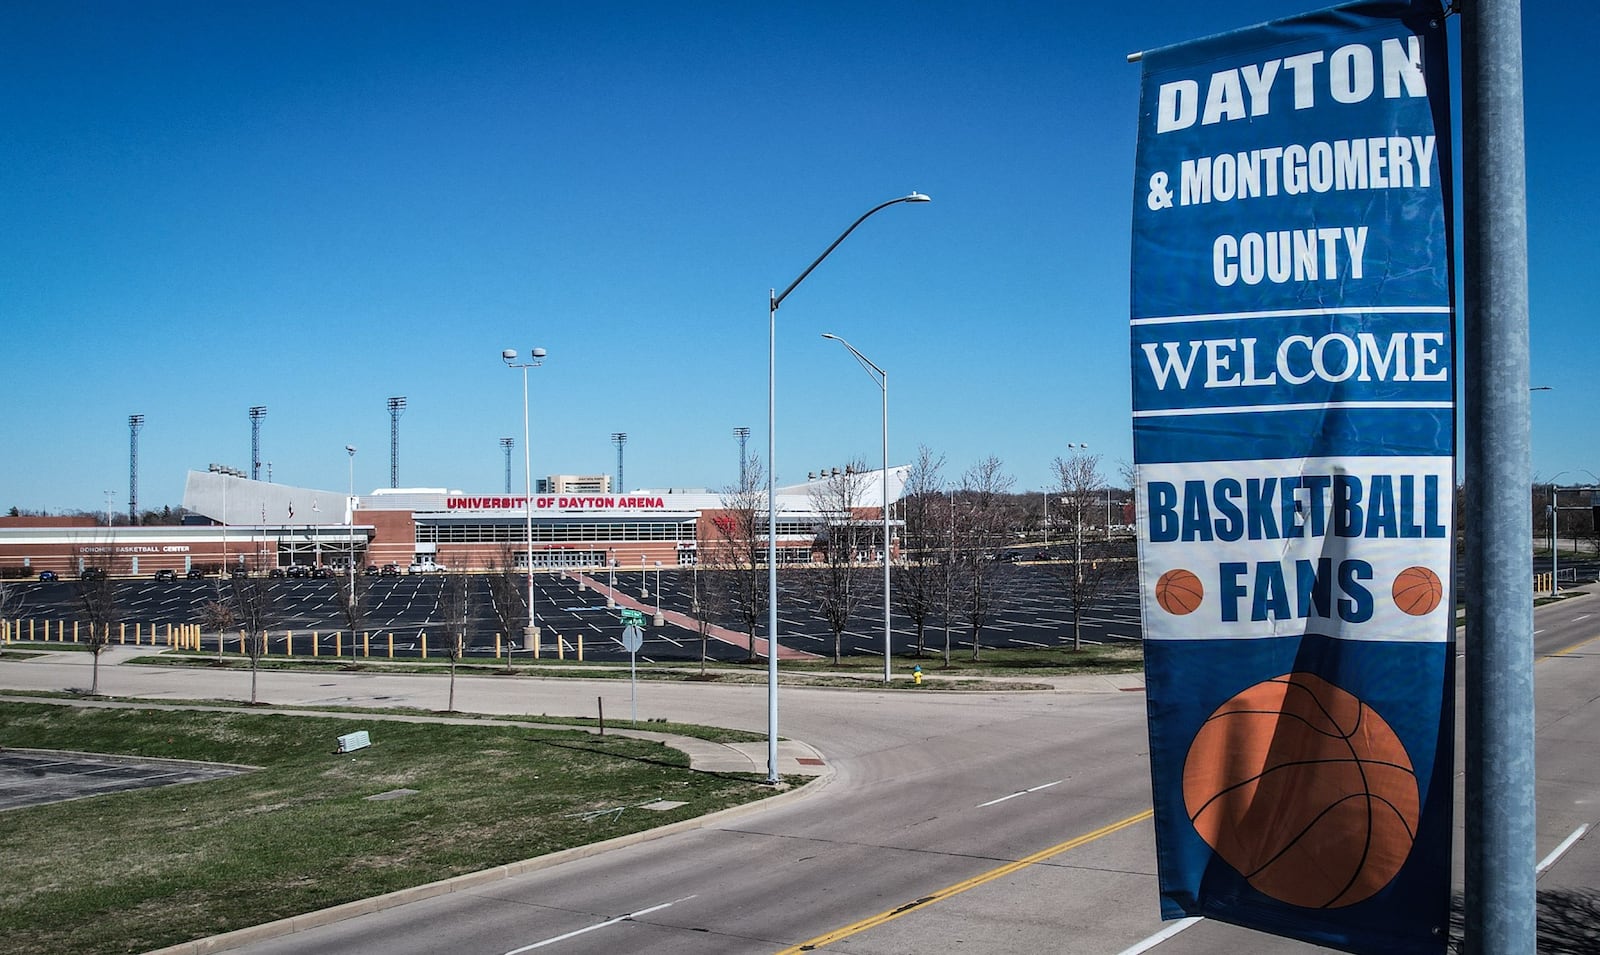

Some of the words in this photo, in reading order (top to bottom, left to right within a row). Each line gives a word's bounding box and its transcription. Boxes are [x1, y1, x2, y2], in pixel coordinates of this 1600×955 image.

[1156, 35, 1428, 134] DAYTON
[1147, 170, 1174, 211] &
[1180, 135, 1436, 207] MONTGOMERY
[1212, 226, 1368, 287] COUNTY
[1141, 331, 1448, 391] WELCOME
[536, 497, 556, 509] OF
[558, 497, 615, 509] DAYTON
[618, 497, 665, 509] ARENA
[1147, 474, 1446, 543] BASKETBALL
[1219, 558, 1374, 624] FANS
